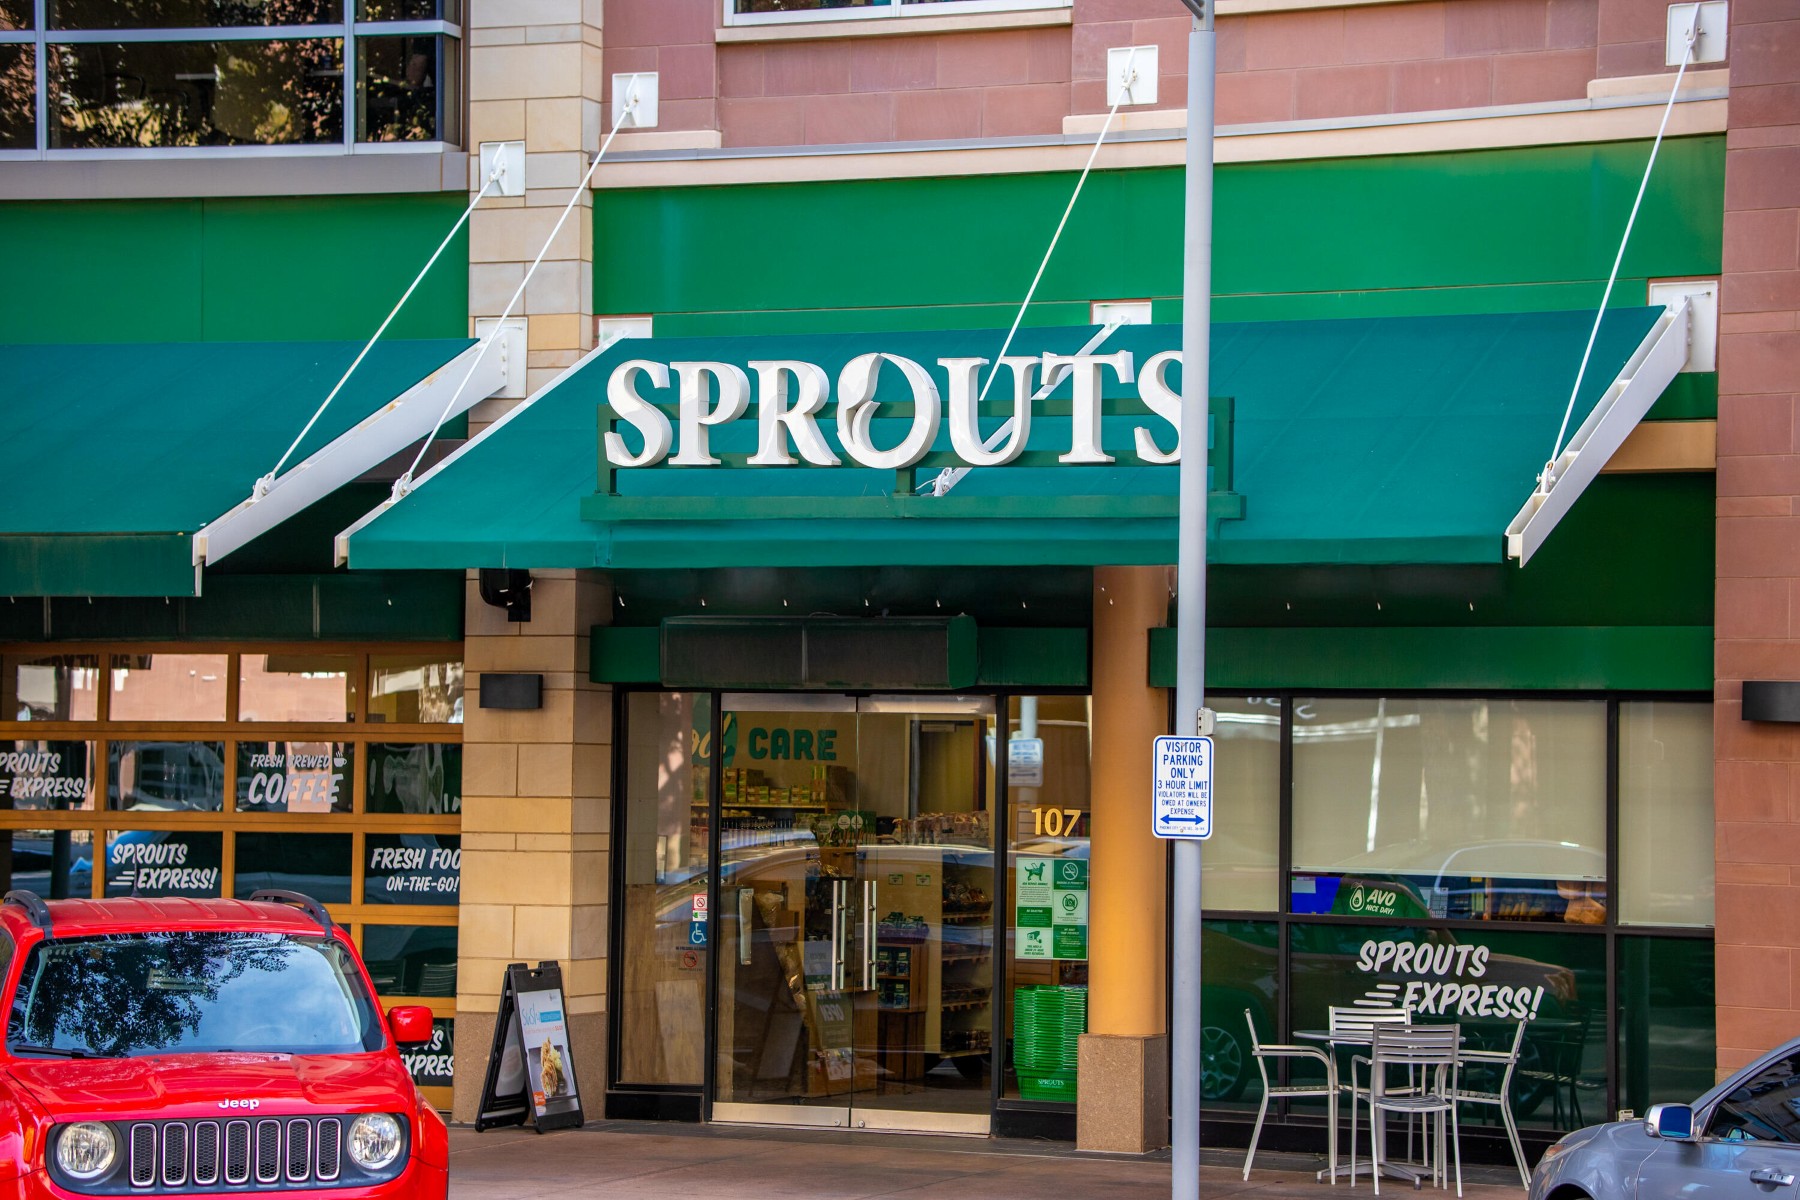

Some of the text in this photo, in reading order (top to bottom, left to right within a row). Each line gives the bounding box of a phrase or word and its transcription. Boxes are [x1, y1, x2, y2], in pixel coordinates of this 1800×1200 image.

[604, 350, 1183, 469] SPROUTS
[748, 727, 837, 760] CARE
[1165, 741, 1201, 753] VISITOR
[250, 754, 331, 768] FRESH BREWED
[1163, 754, 1203, 766] PARKING
[1170, 767, 1195, 779] ONLY
[10, 777, 91, 798] EXPRESS!
[248, 772, 344, 804] COFFEE
[1158, 780, 1208, 790] 3 HOUR LIMIT
[1188, 791, 1199, 799] WILL
[1170, 808, 1195, 816] EXPENSE
[1031, 807, 1081, 838] 107
[111, 843, 188, 865] SPROUTS
[370, 847, 426, 870] FRESH
[137, 867, 218, 890] EXPRESS!
[386, 876, 460, 892] ON-THE-GO!
[1366, 889, 1396, 907] AVO
[1365, 905, 1395, 916] NICE DAY!
[1356, 940, 1490, 977] SPROUTS
[1402, 981, 1545, 1020] EXPRESS!
[400, 1054, 455, 1076] XPRES
[218, 1098, 260, 1110] Jeep
